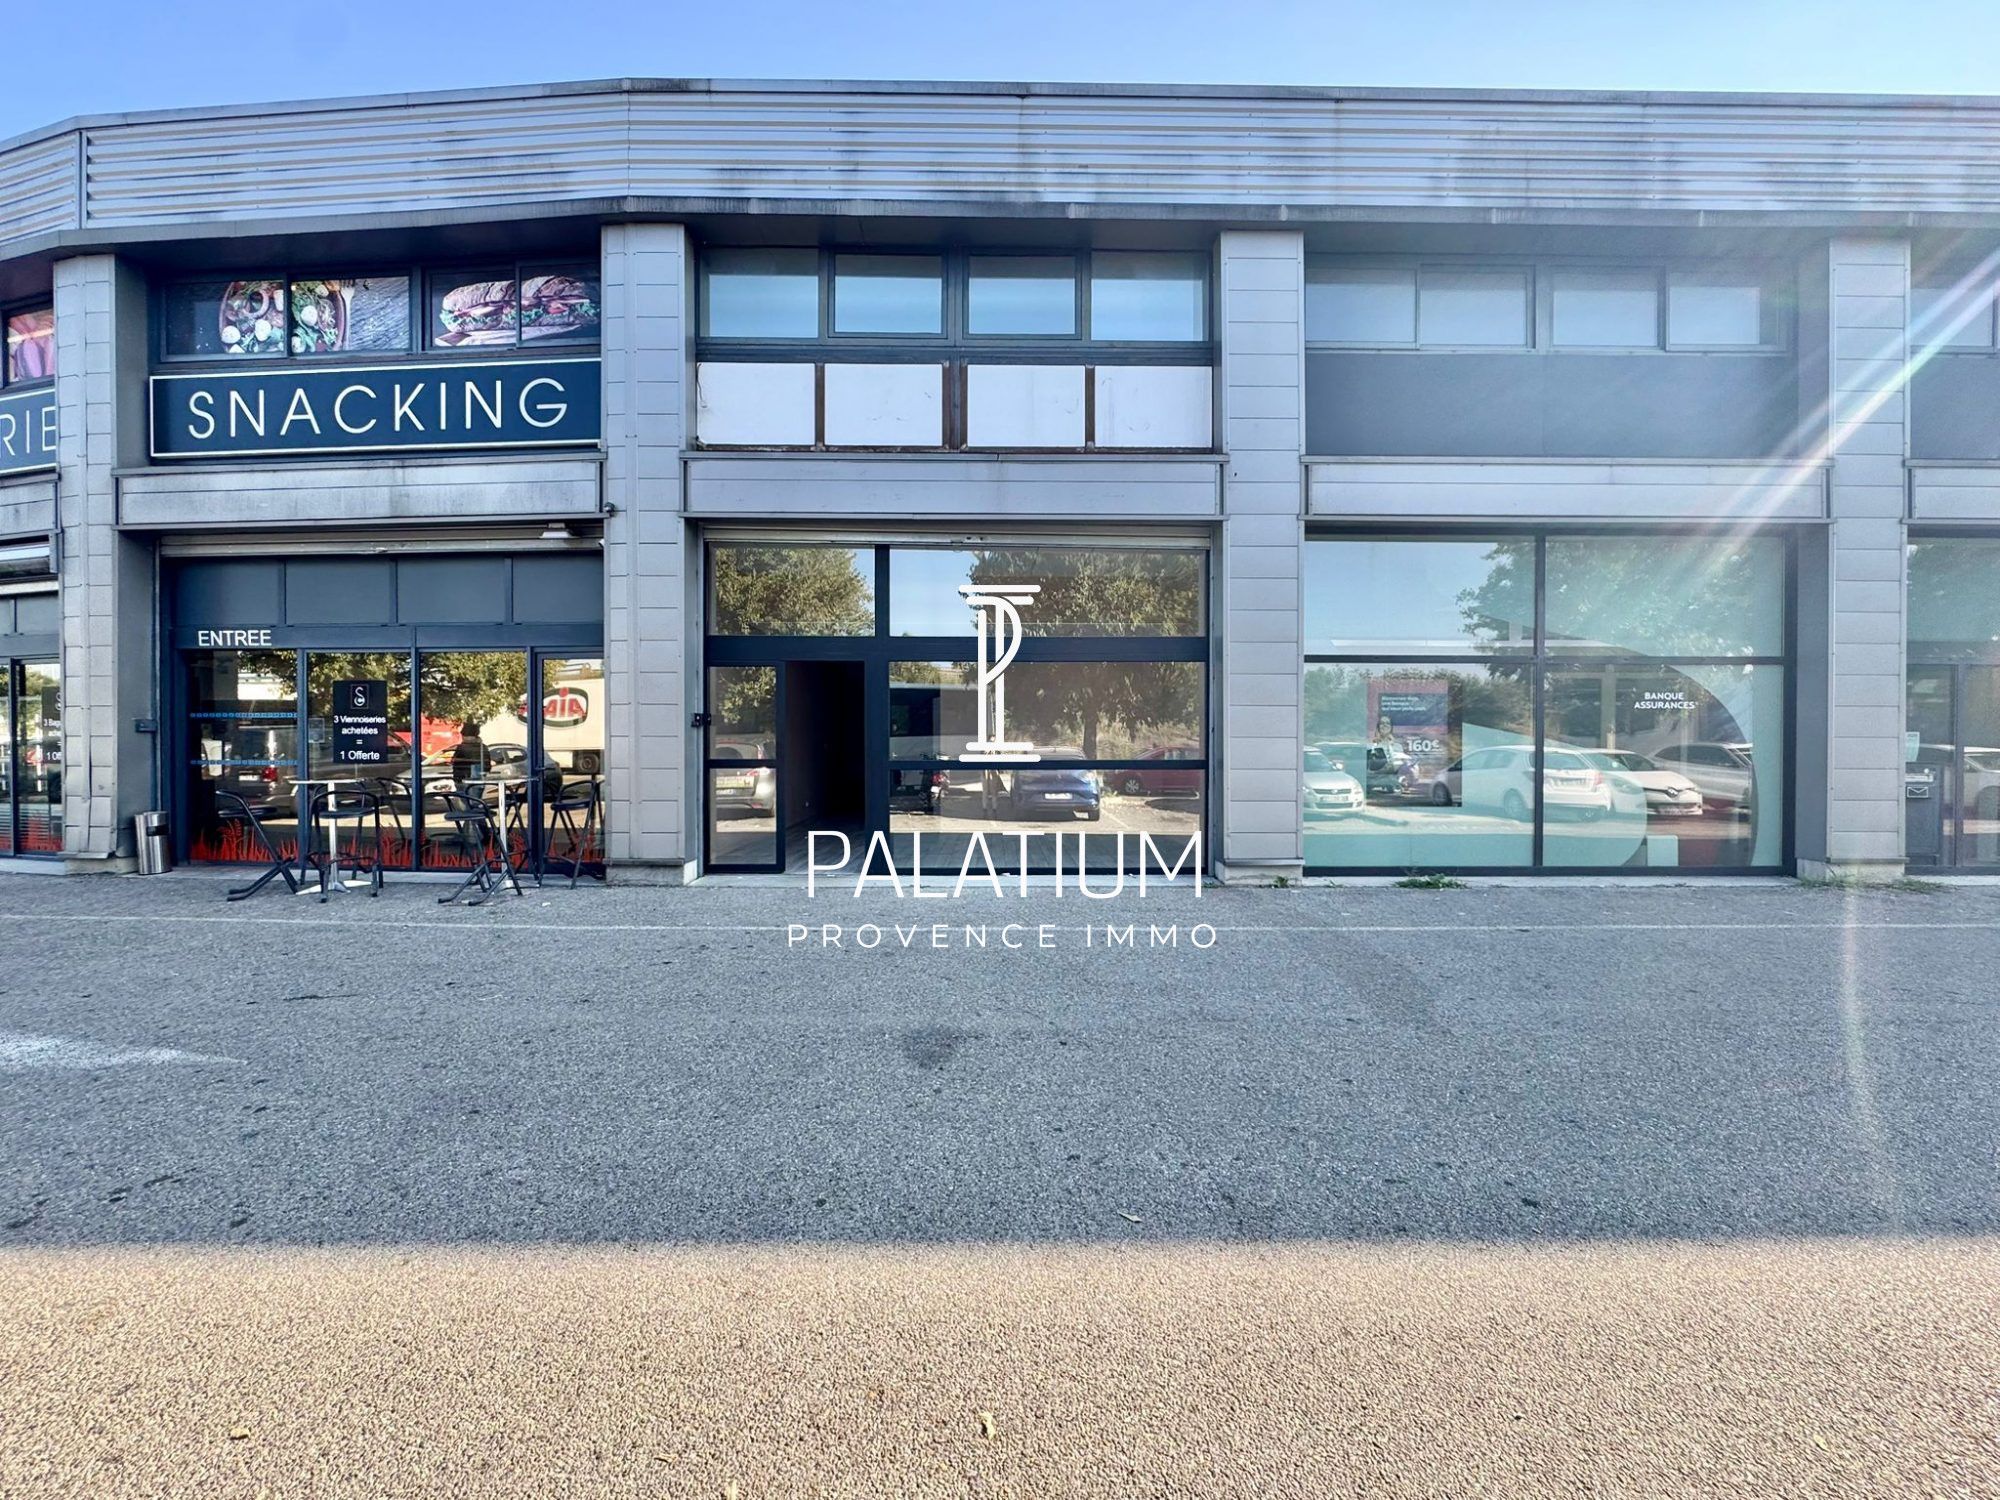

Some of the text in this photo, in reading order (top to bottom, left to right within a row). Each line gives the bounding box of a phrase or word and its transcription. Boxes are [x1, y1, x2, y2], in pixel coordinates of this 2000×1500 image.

[188, 377, 568, 440] SNACKING
[0, 405, 57, 456] RIE
[197, 629, 273, 647] ENTREE
[1644, 691, 1685, 701] BANQUE
[333, 715, 386, 723] 3 Viennoiseries
[341, 726, 378, 734] achetées
[340, 750, 380, 760] 1 Offerte
